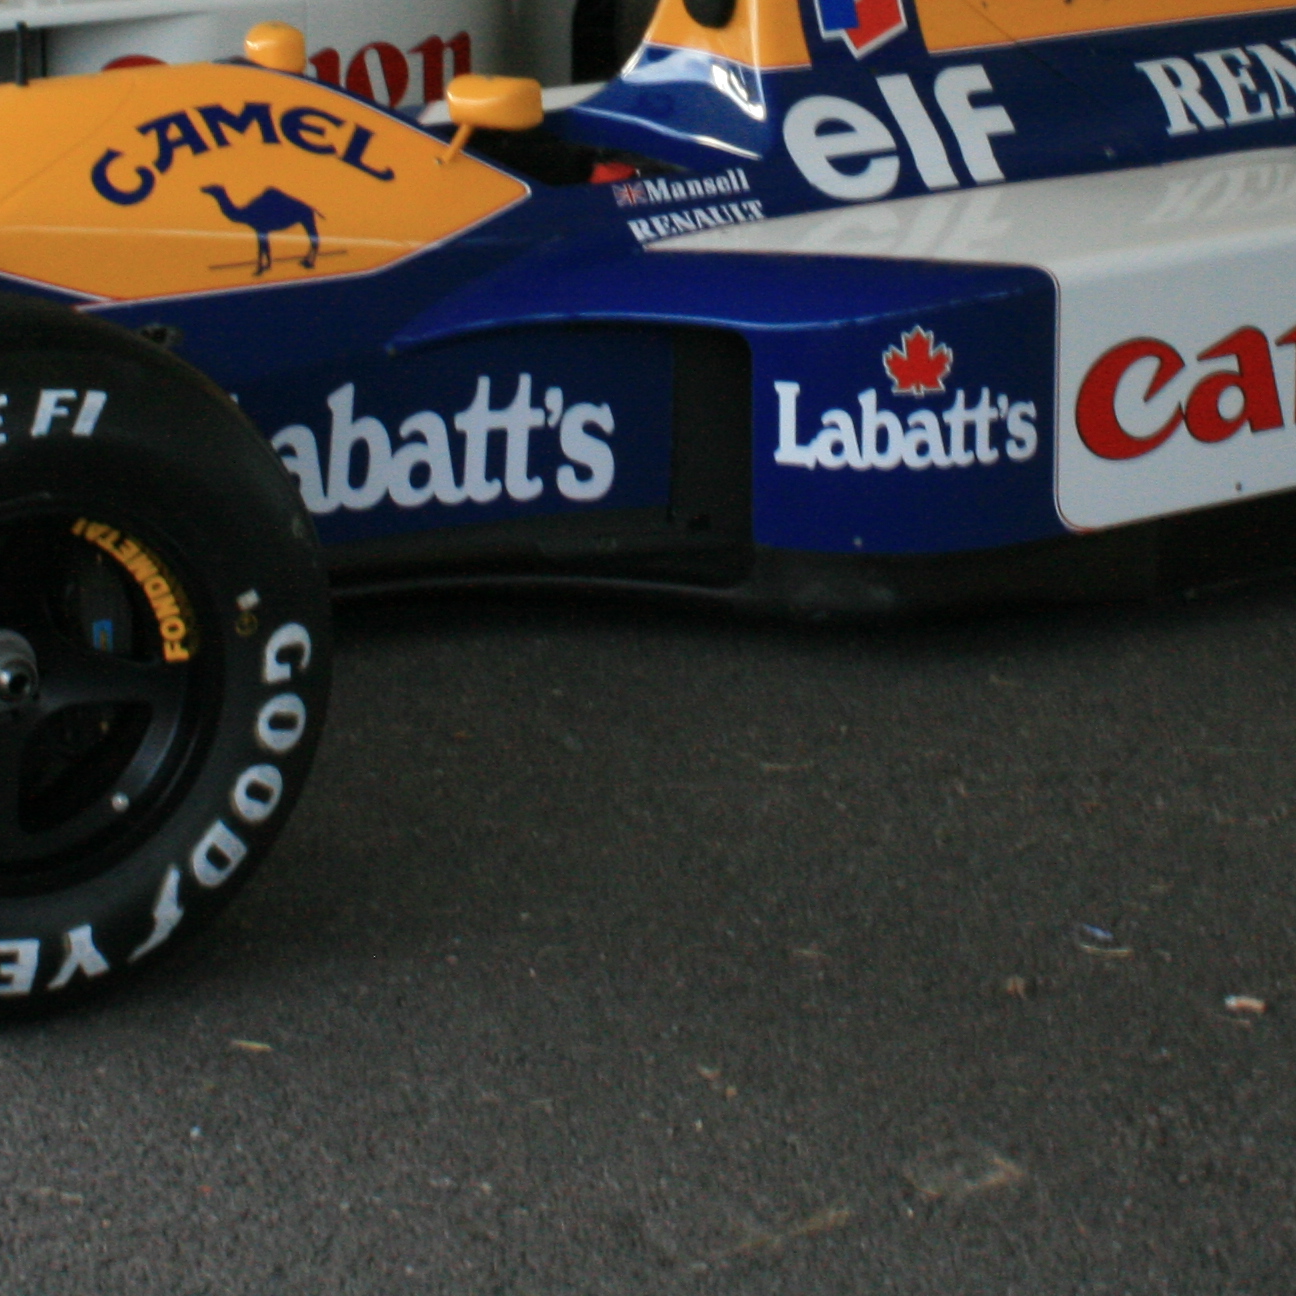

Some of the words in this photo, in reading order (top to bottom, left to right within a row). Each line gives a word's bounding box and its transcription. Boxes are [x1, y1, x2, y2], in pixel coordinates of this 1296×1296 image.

[90, 101, 396, 206] CAMEL
[784, 64, 1016, 202] elf
[626, 199, 766, 244] RENAULT
[642, 166, 751, 203] Mansell
[773, 379, 1039, 471] Labatt's
